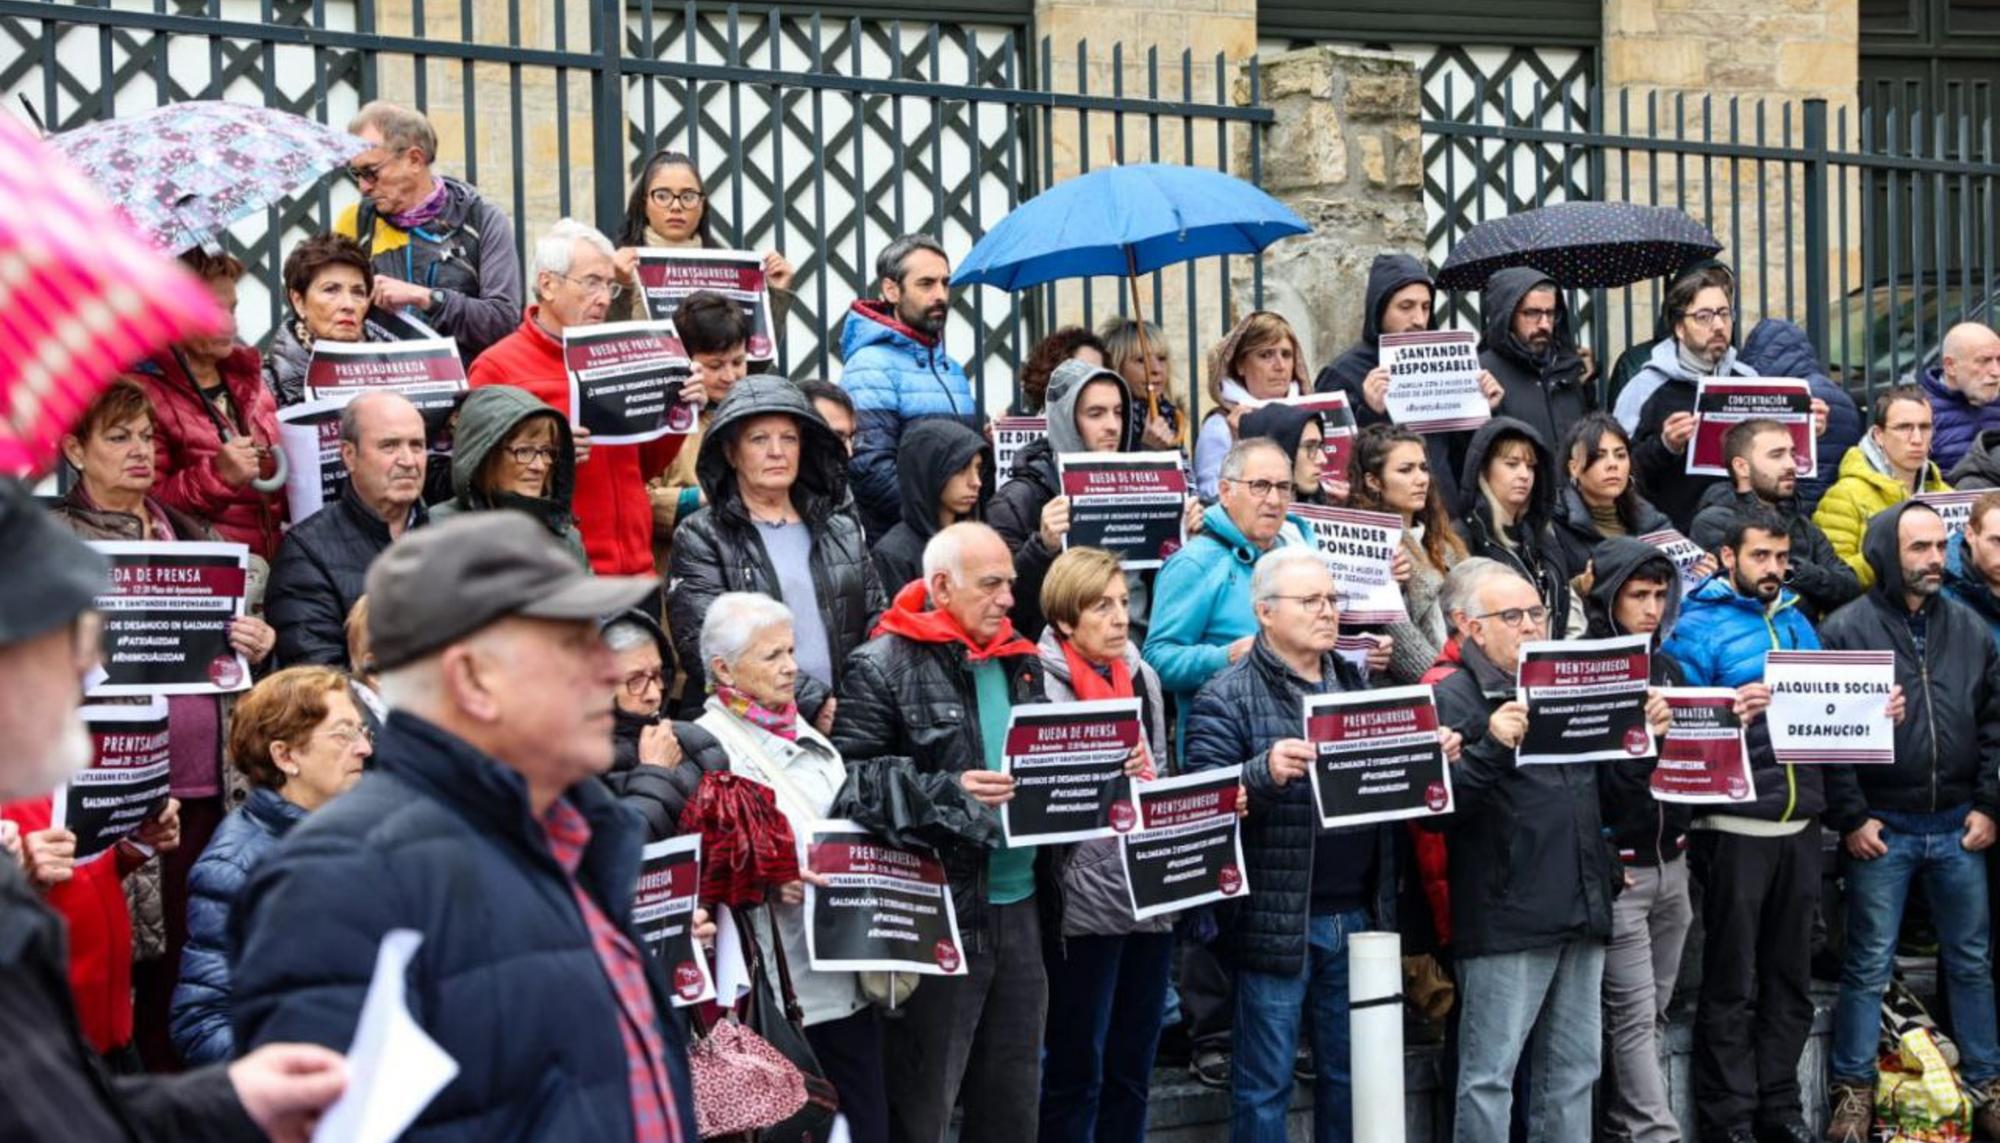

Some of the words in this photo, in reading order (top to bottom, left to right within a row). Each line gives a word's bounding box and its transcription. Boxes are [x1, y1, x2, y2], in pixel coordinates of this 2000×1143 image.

[1395, 345, 1470, 362] ¡SANTANDER
[1390, 360, 1477, 375] RESPONSABLE!
[1000, 432, 1012, 443] EZ
[1313, 522, 1387, 542] ANTANDER
[1317, 539, 1393, 560] PONSABLE!
[108, 568, 131, 582] EDA
[136, 568, 151, 581] DE
[157, 568, 201, 583] PRENSA
[1845, 682, 1890, 693] SOCIAL
[1826, 703, 1836, 715] O
[1038, 726, 1067, 740] RUEDA
[1070, 725, 1082, 739] DE
[1084, 724, 1117, 739] PRENSA
[1788, 724, 1870, 736] DESAHUCIO!
